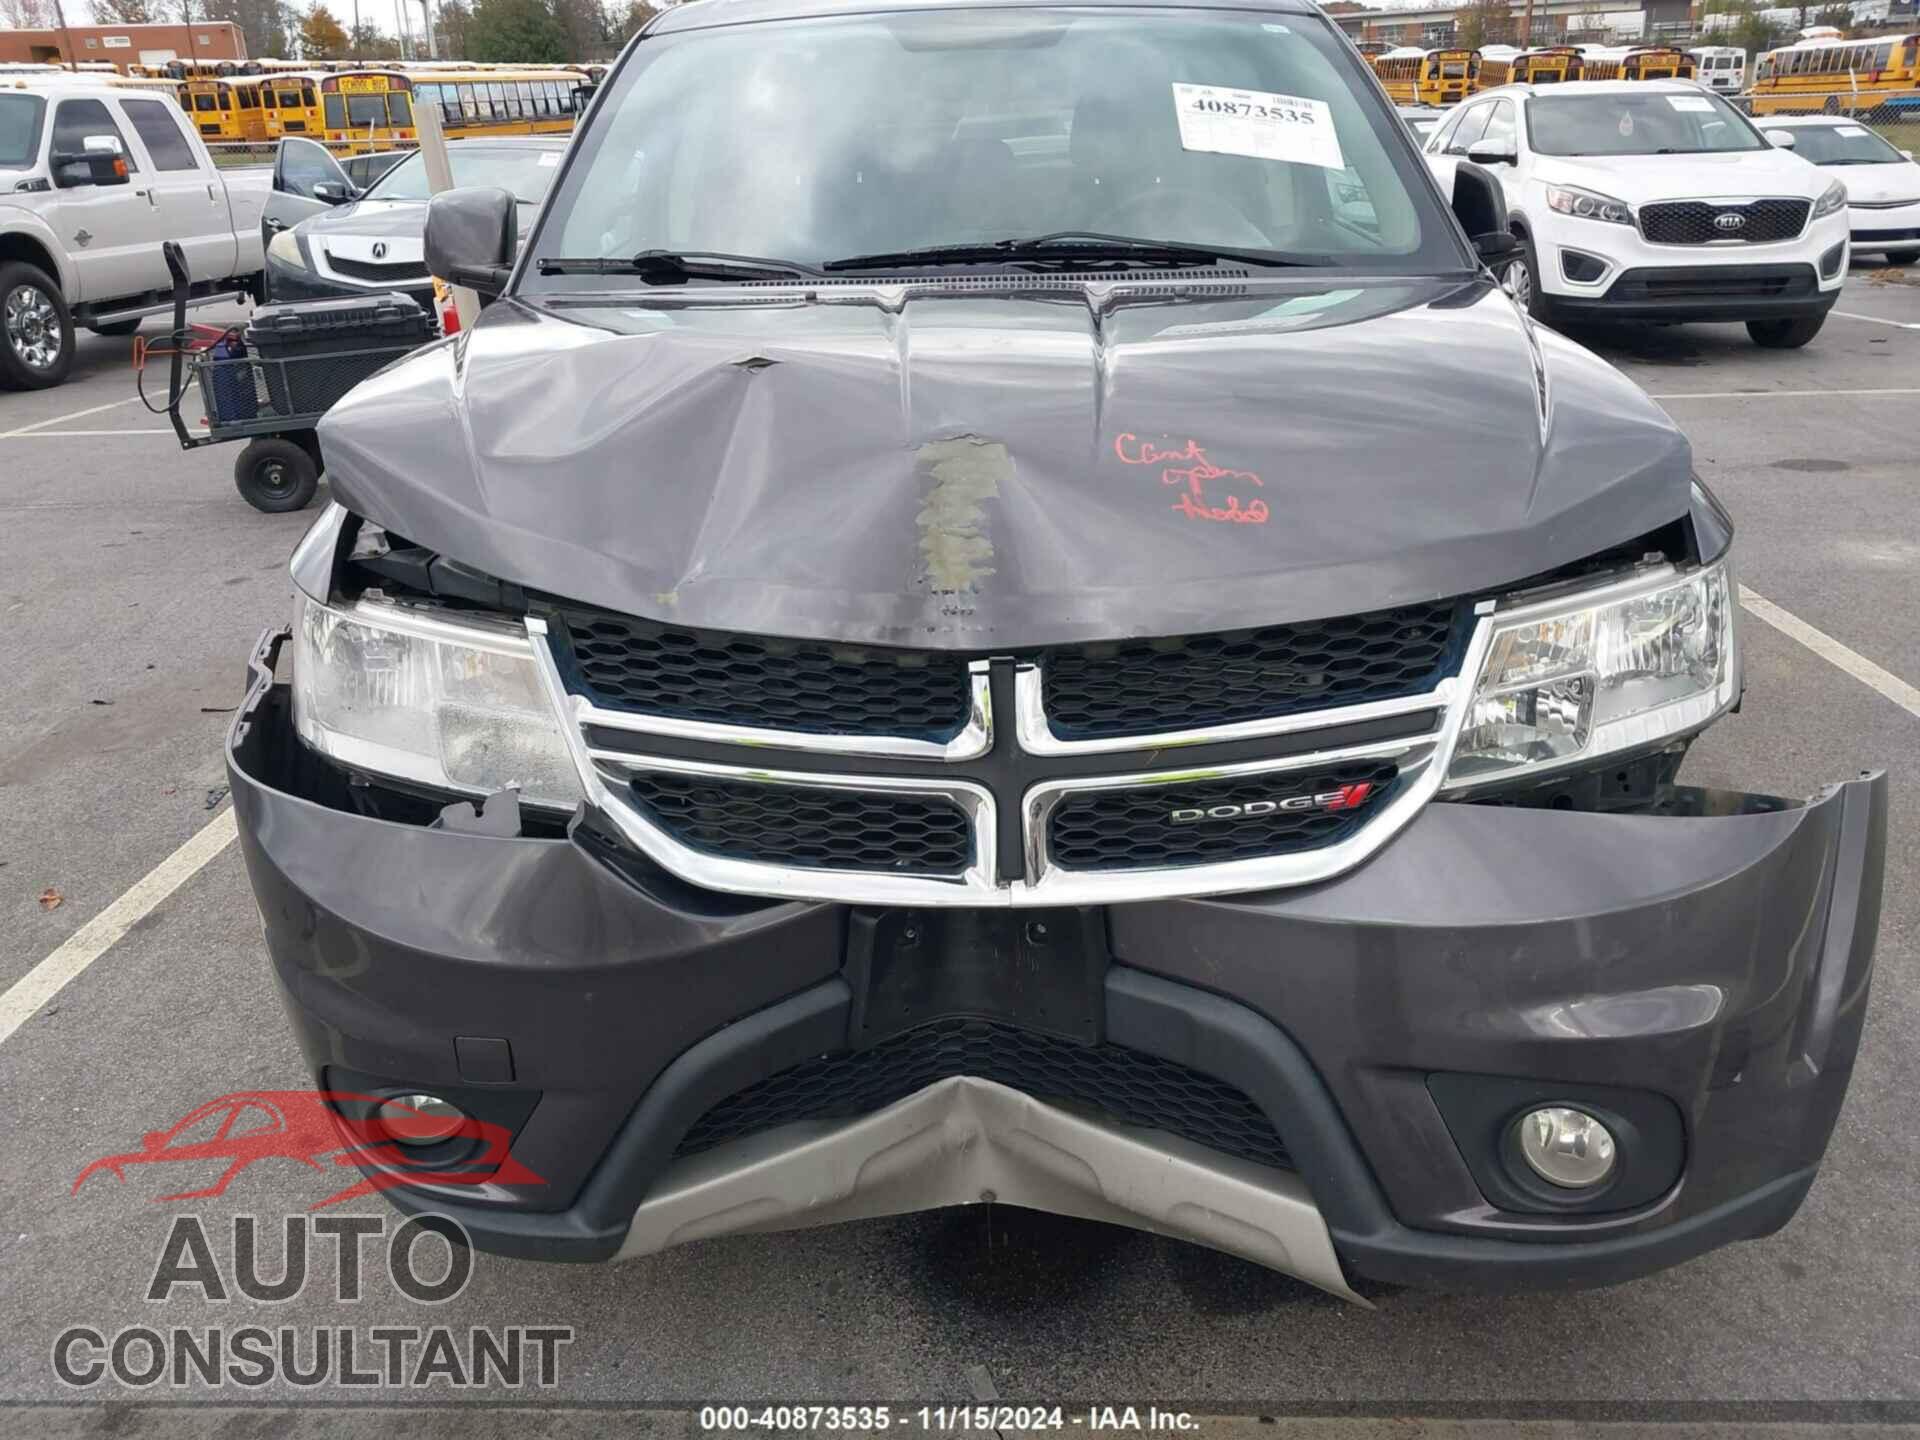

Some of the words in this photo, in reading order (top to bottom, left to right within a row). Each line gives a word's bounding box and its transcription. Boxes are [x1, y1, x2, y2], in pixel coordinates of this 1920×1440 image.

[1191, 98, 1317, 126] 40873535
[1719, 217, 1741, 227] KIA
[1171, 791, 1345, 823] DODGE
